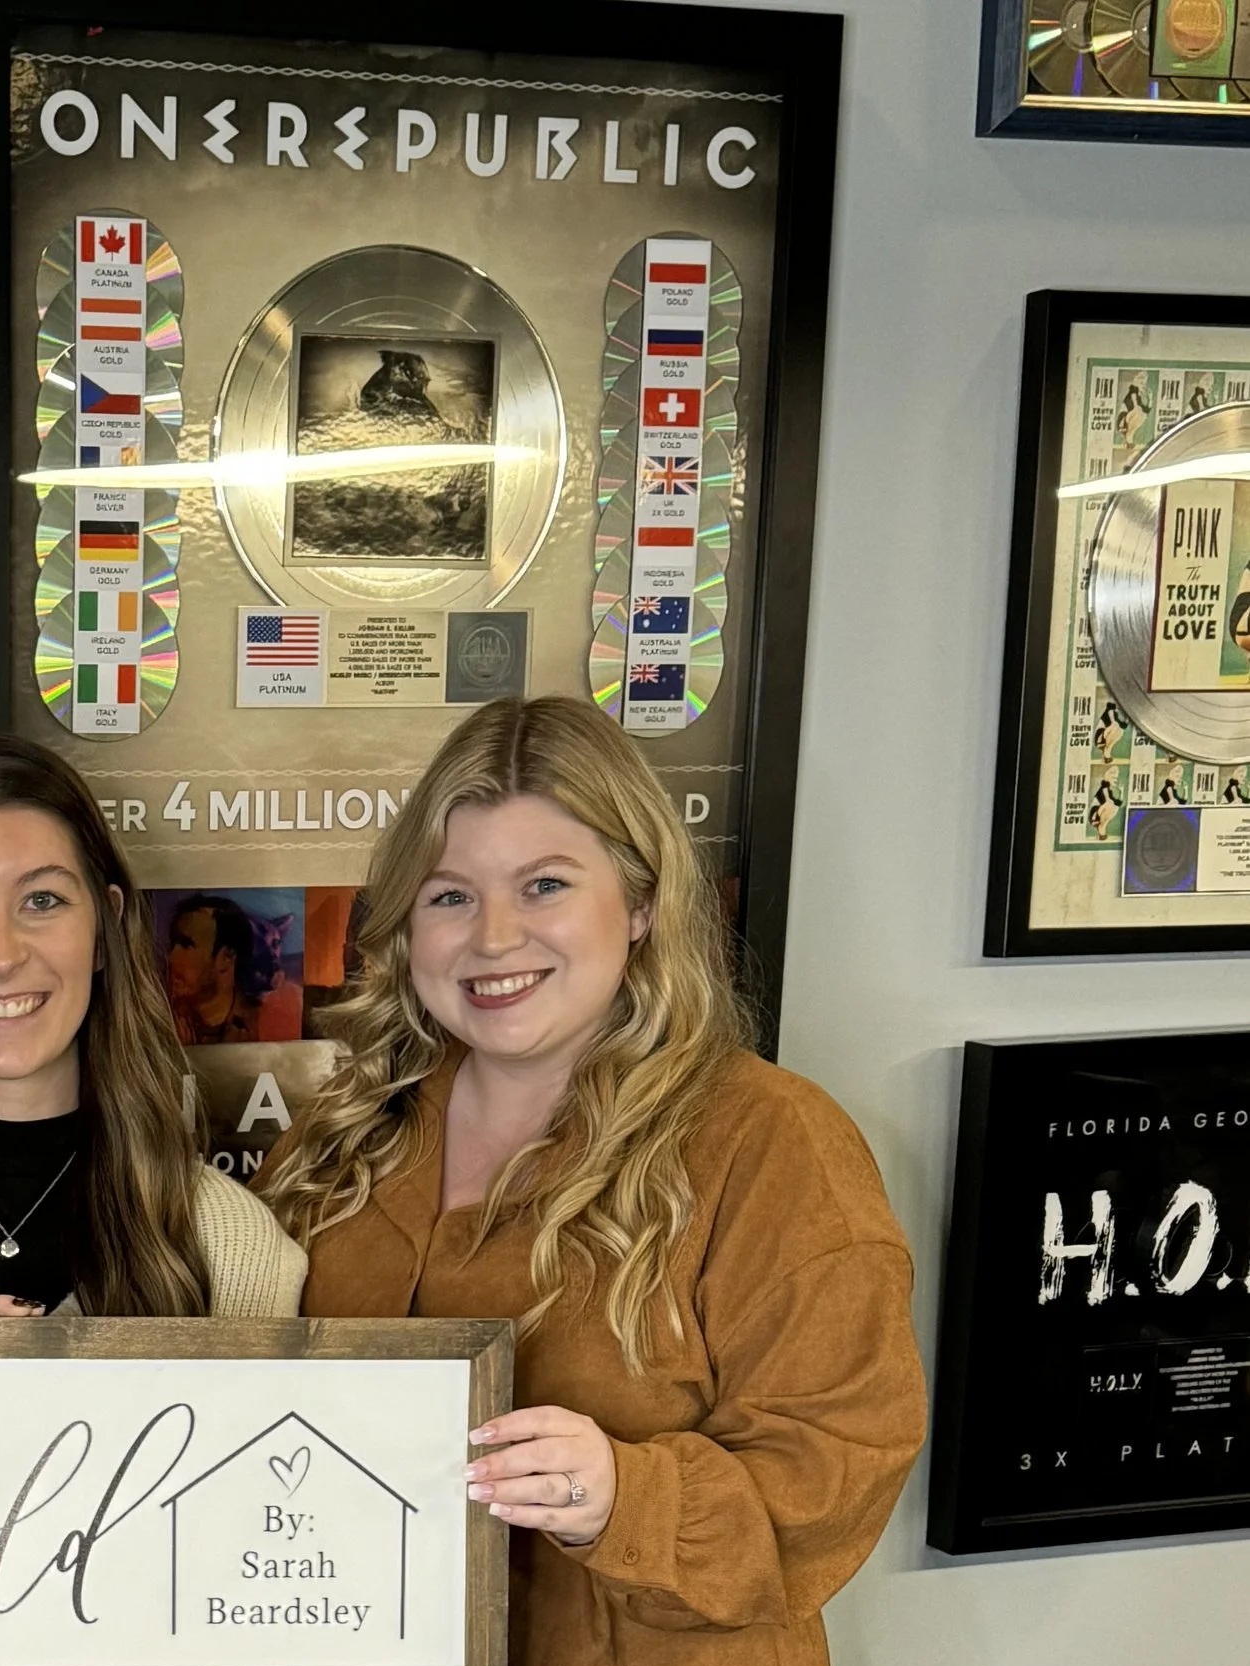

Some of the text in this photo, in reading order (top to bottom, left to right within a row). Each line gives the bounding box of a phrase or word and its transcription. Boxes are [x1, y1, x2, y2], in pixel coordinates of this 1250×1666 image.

[38, 88, 758, 190] ONEREPUBLIC
[94, 268, 129, 278] CANADA
[91, 278, 133, 289] PLATINUM
[661, 288, 693, 297] POLAND
[666, 298, 689, 306] GOLD
[93, 345, 130, 354] AUSTRIA
[99, 356, 124, 366] GOLD
[659, 359, 689, 369] RUSSIA
[662, 369, 685, 378] GOLD
[106, 420, 141, 429] REPUBLIC
[99, 430, 123, 439] GOLD
[643, 430, 699, 440] SWITZERLAND
[660, 441, 682, 449] GOLD
[93, 492, 127, 502] FRANCE
[95, 503, 125, 512] SILVER
[663, 509, 686, 518] GOLD
[1173, 507, 1222, 558] P!NK
[89, 566, 130, 576] GERMANY
[643, 570, 685, 578] INDONESIA
[97, 577, 121, 585] GOLD
[652, 579, 674, 588] GOLD
[1166, 584, 1221, 601] TRUTH
[1168, 603, 1215, 617] ABOUT
[1162, 619, 1217, 641] LOVE
[90, 636, 126, 645] IRELAND
[639, 638, 681, 647] AUSTRALIA
[96, 646, 120, 656] GOLD
[640, 648, 678, 656] PLATINUM
[272, 672, 292, 682] USA
[259, 685, 307, 695] PLATINUM
[95, 708, 118, 717] ITALY
[629, 706, 683, 714] NEW ZEALAND
[95, 718, 118, 727] GOLD
[644, 714, 666, 723] GOLD
[1069, 738, 1091, 747] LOVE
[162, 780, 198, 832] 4
[208, 788, 411, 832] MILLION
[1064, 815, 1085, 825] LOVE
[1049, 1109, 1249, 1138] FLORIDA GEO
[262, 1505, 315, 1541] By:
[241, 1550, 338, 1580] Sarah
[206, 1596, 372, 1633] Beardsley
